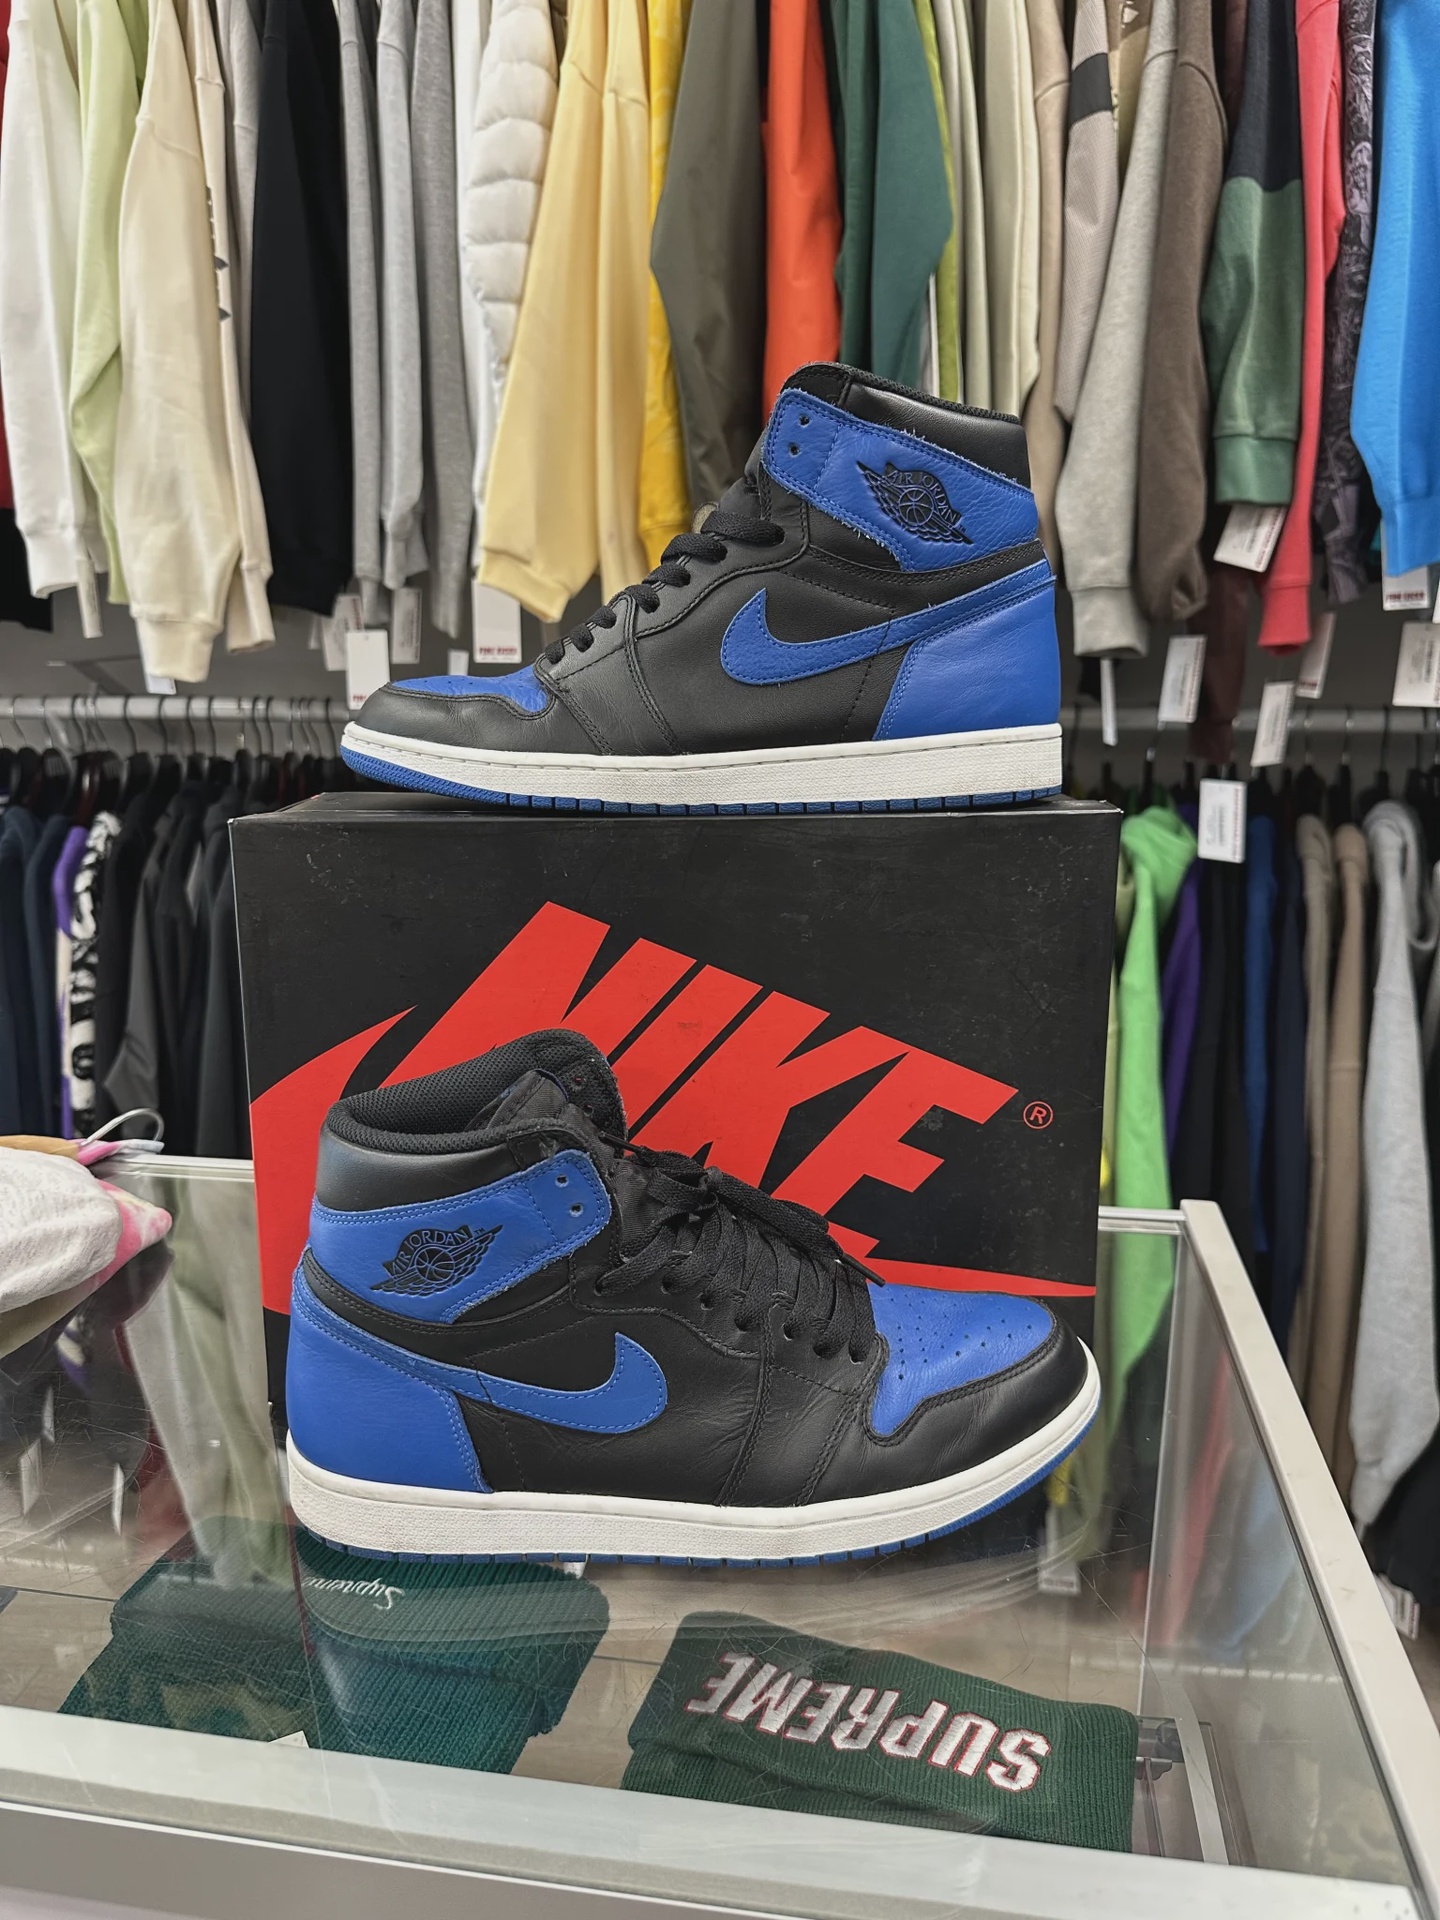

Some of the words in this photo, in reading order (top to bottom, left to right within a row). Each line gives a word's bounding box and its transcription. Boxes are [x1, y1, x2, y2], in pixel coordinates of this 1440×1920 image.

[885, 469, 914, 486] AIR
[917, 471, 958, 524] JORDAN
[377, 900, 1019, 1258] NIKE
[391, 1250, 412, 1276] AIR
[403, 1228, 469, 1252] JORDAN
[684, 1651, 1051, 1793] SUPREME
